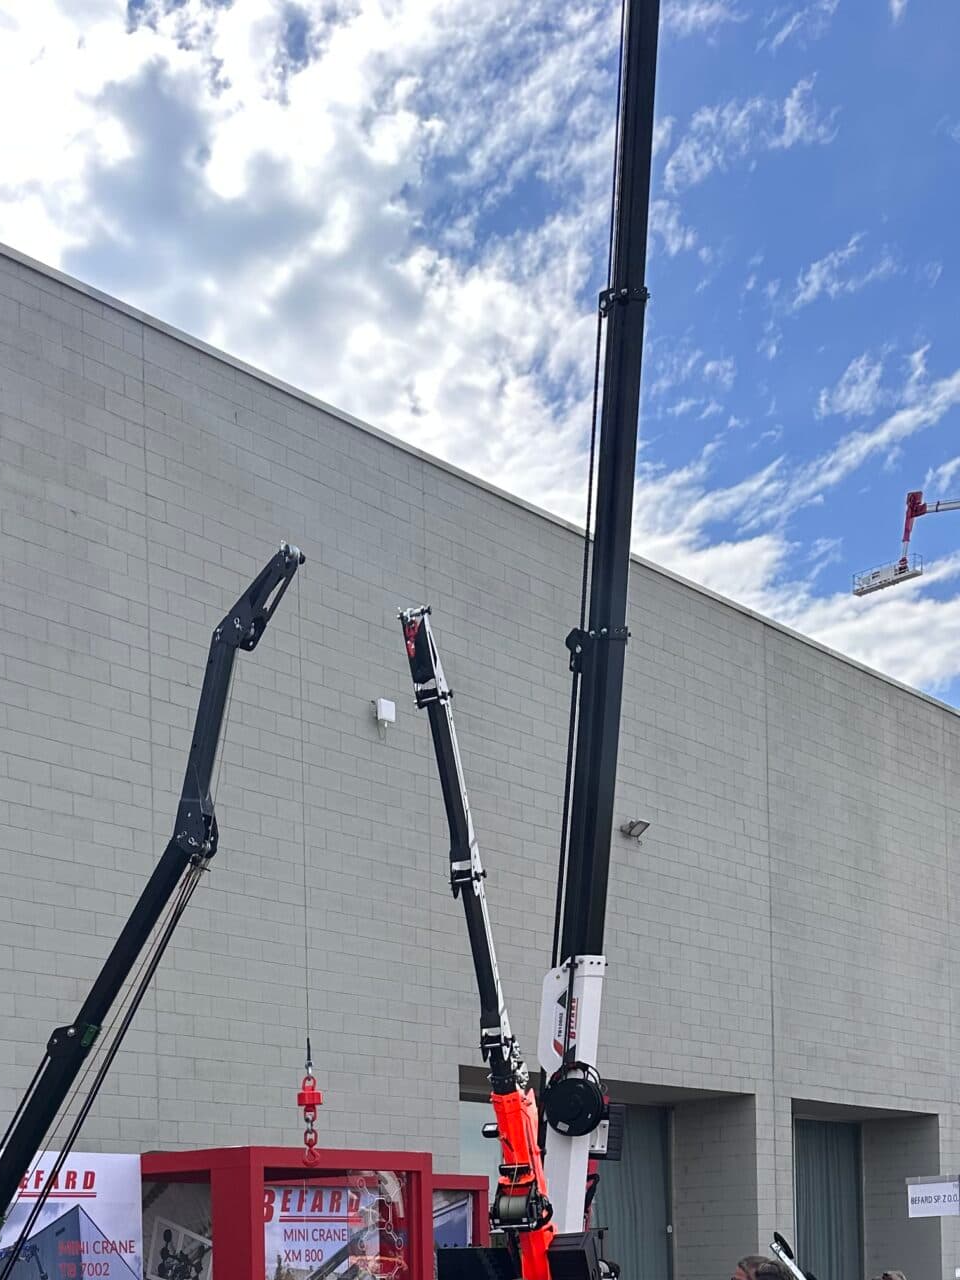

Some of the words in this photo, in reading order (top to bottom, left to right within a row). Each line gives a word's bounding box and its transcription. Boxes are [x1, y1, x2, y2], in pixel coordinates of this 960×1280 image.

[283, 1228, 309, 1242] MINI
[311, 1228, 348, 1242] CRANE
[58, 1241, 89, 1256] MINI
[93, 1240, 136, 1255] CRANE
[284, 1249, 302, 1262] XM
[304, 1248, 324, 1262] 800
[80, 1262, 110, 1277] 7002
